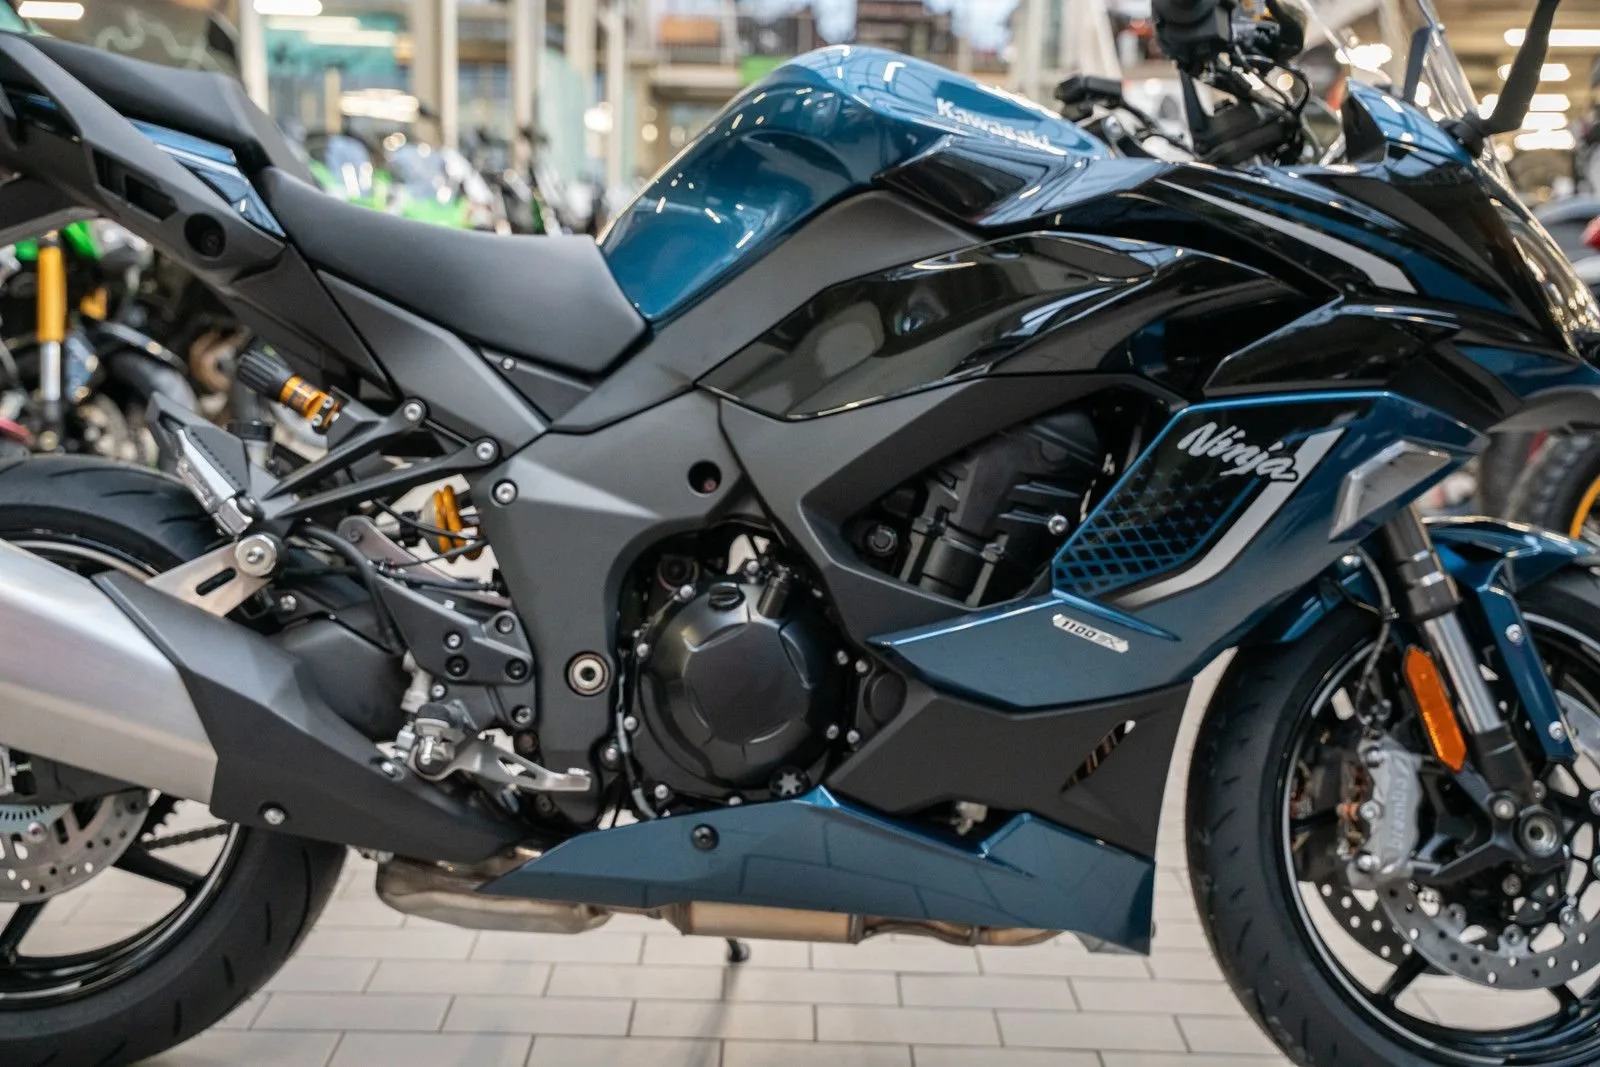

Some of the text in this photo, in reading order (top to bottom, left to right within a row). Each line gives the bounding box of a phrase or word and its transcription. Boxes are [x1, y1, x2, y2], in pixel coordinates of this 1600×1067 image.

[936, 97, 1050, 151] Kawasaki
[1177, 421, 1297, 481] Ninja
[1062, 620, 1097, 639] 1100
